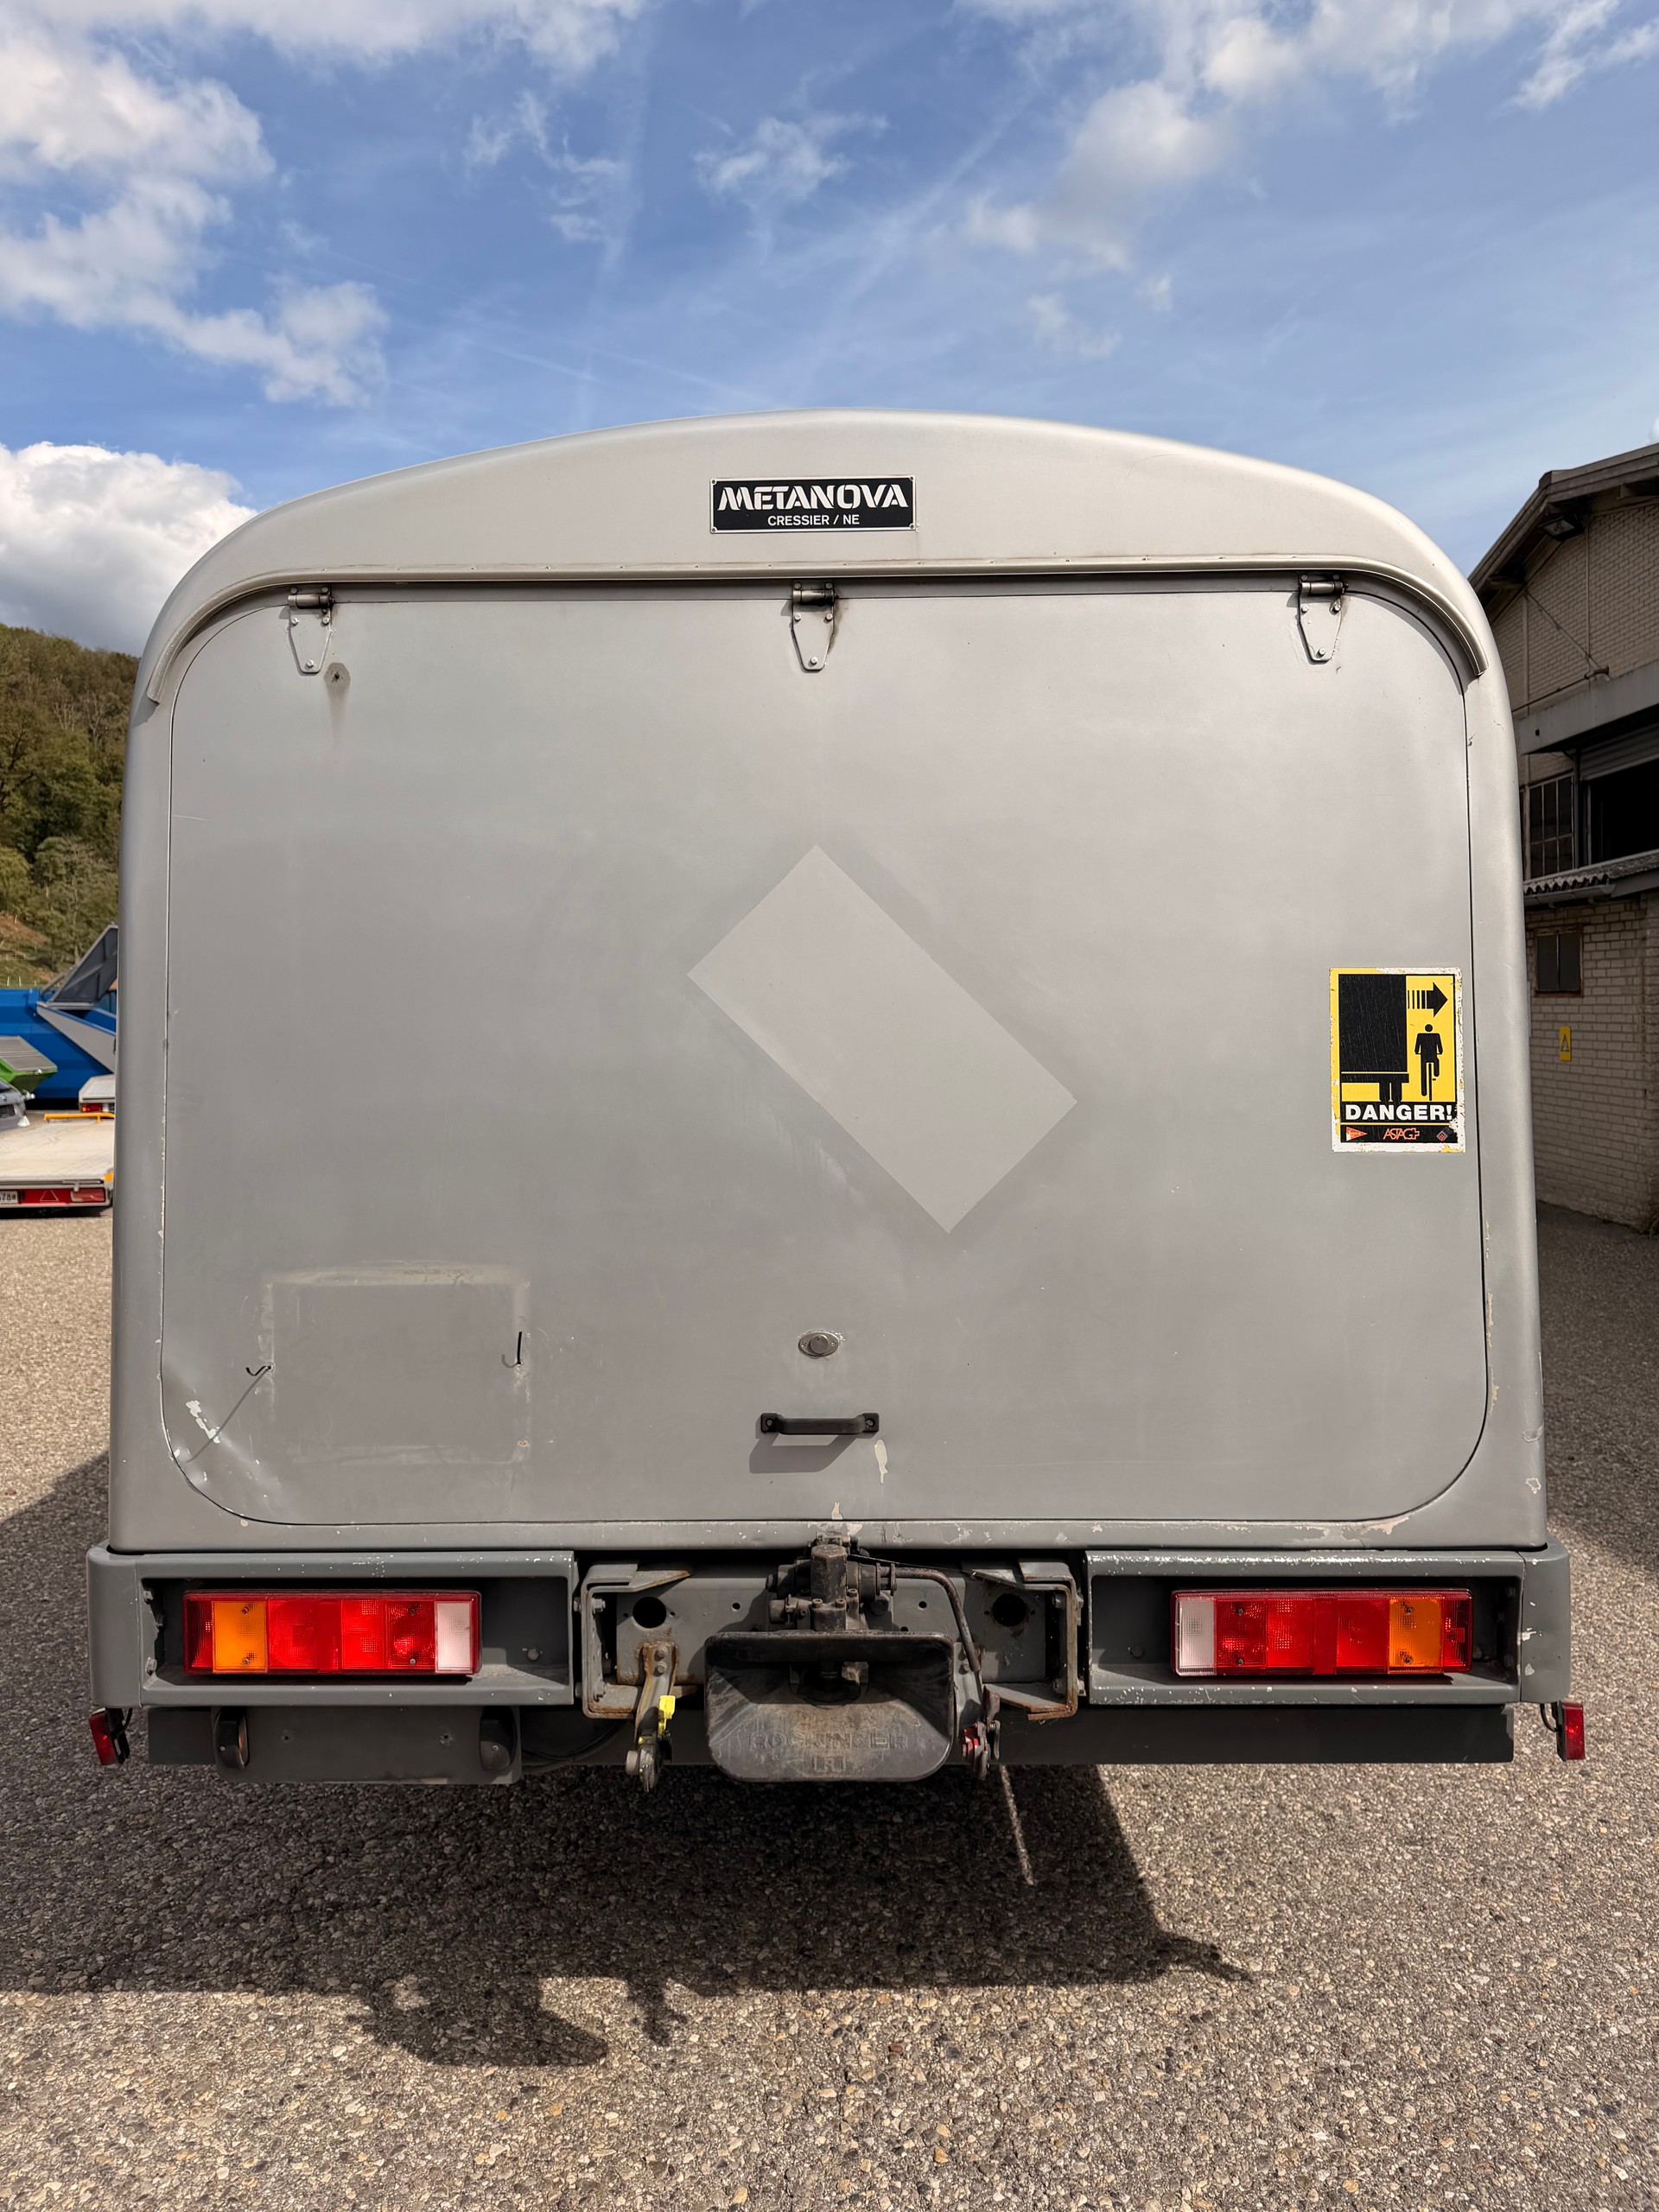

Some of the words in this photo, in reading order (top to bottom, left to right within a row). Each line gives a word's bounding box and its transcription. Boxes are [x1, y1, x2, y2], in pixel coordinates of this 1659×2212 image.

[717, 484, 909, 511] METANOVA
[767, 515, 830, 526] CRESSIER
[843, 514, 860, 525] NE
[1345, 1104, 1452, 1121] DANGER!
